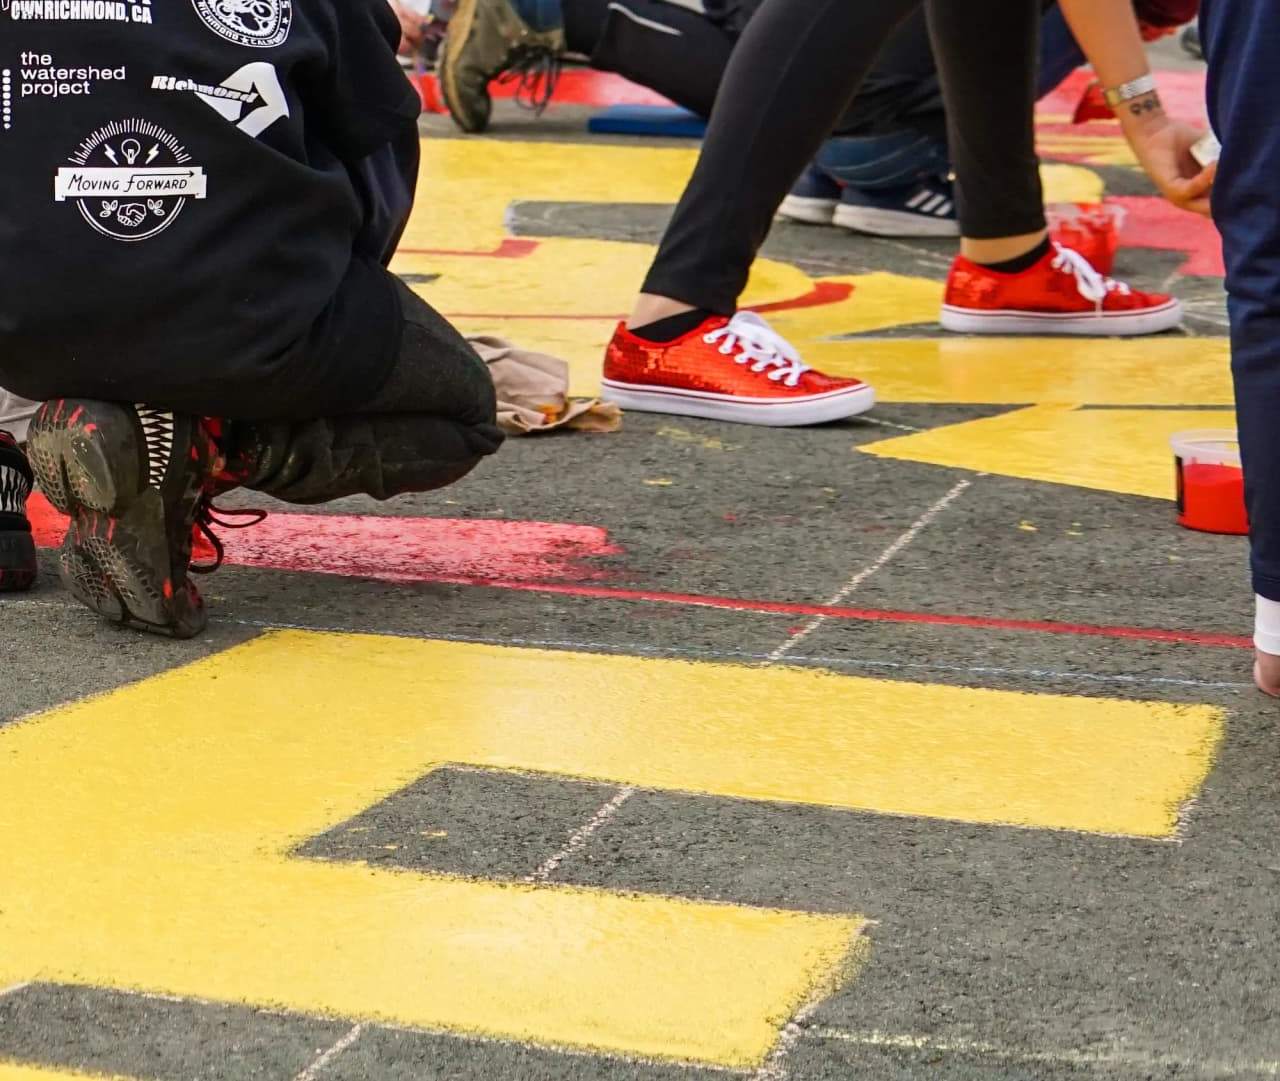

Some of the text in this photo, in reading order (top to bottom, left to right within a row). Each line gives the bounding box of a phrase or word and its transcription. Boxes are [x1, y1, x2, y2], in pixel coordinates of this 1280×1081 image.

[131, 4, 153, 25] CA
[198, 1, 239, 40] RICHMOND
[20, 51, 52, 66] the
[20, 66, 126, 80] watershed
[21, 80, 91, 97] project
[67, 174, 120, 192] MOVING
